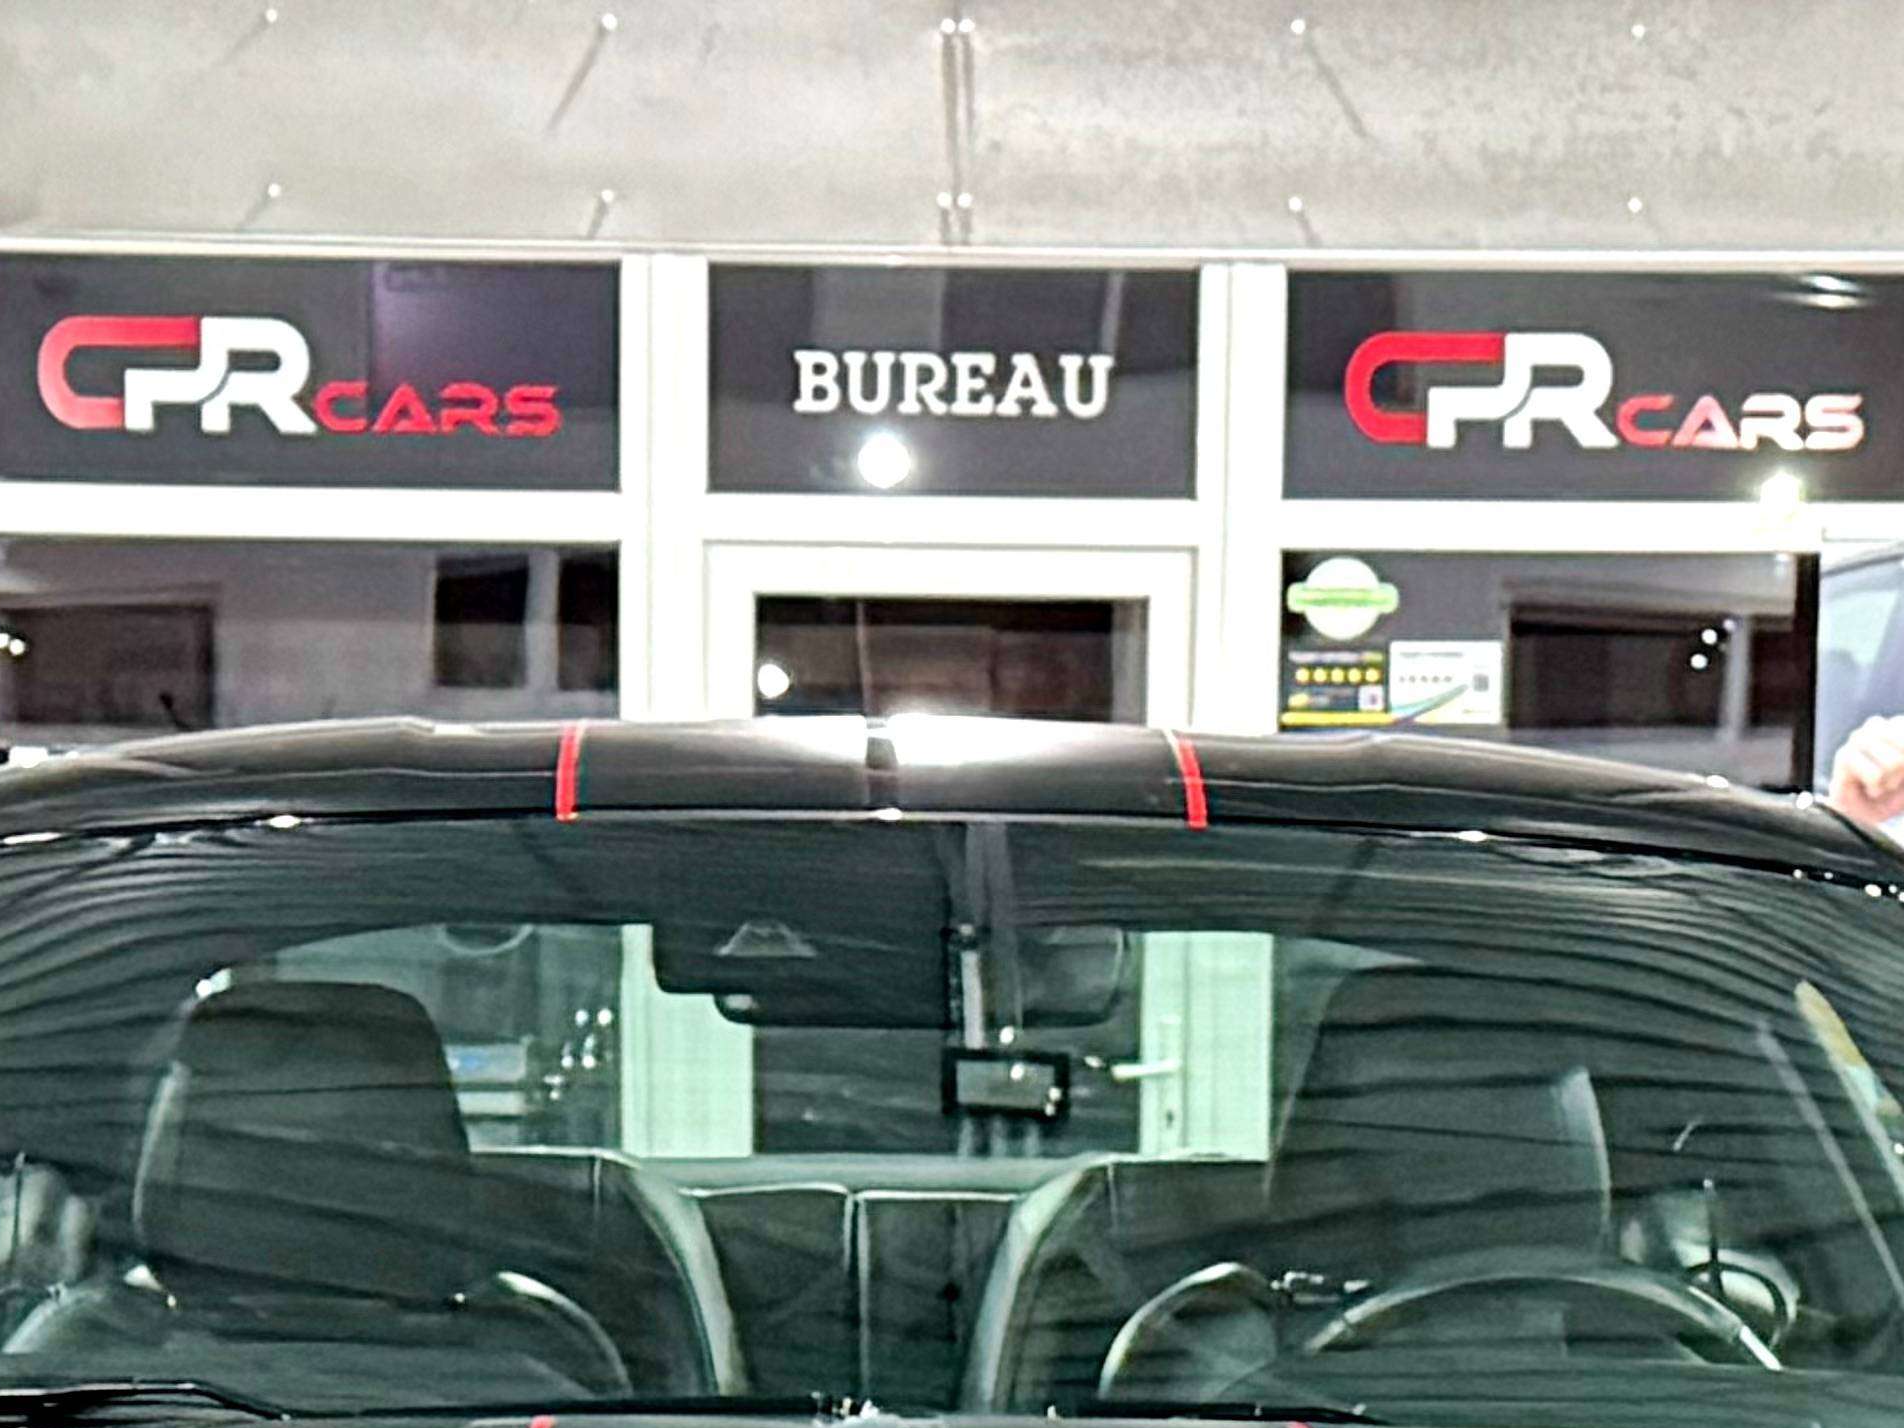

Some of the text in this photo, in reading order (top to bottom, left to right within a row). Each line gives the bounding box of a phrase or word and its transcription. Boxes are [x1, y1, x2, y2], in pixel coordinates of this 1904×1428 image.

[37, 314, 562, 438] CPR CARS
[793, 349, 1115, 420] BUREAU
[1343, 331, 1864, 451] CPR CARS
